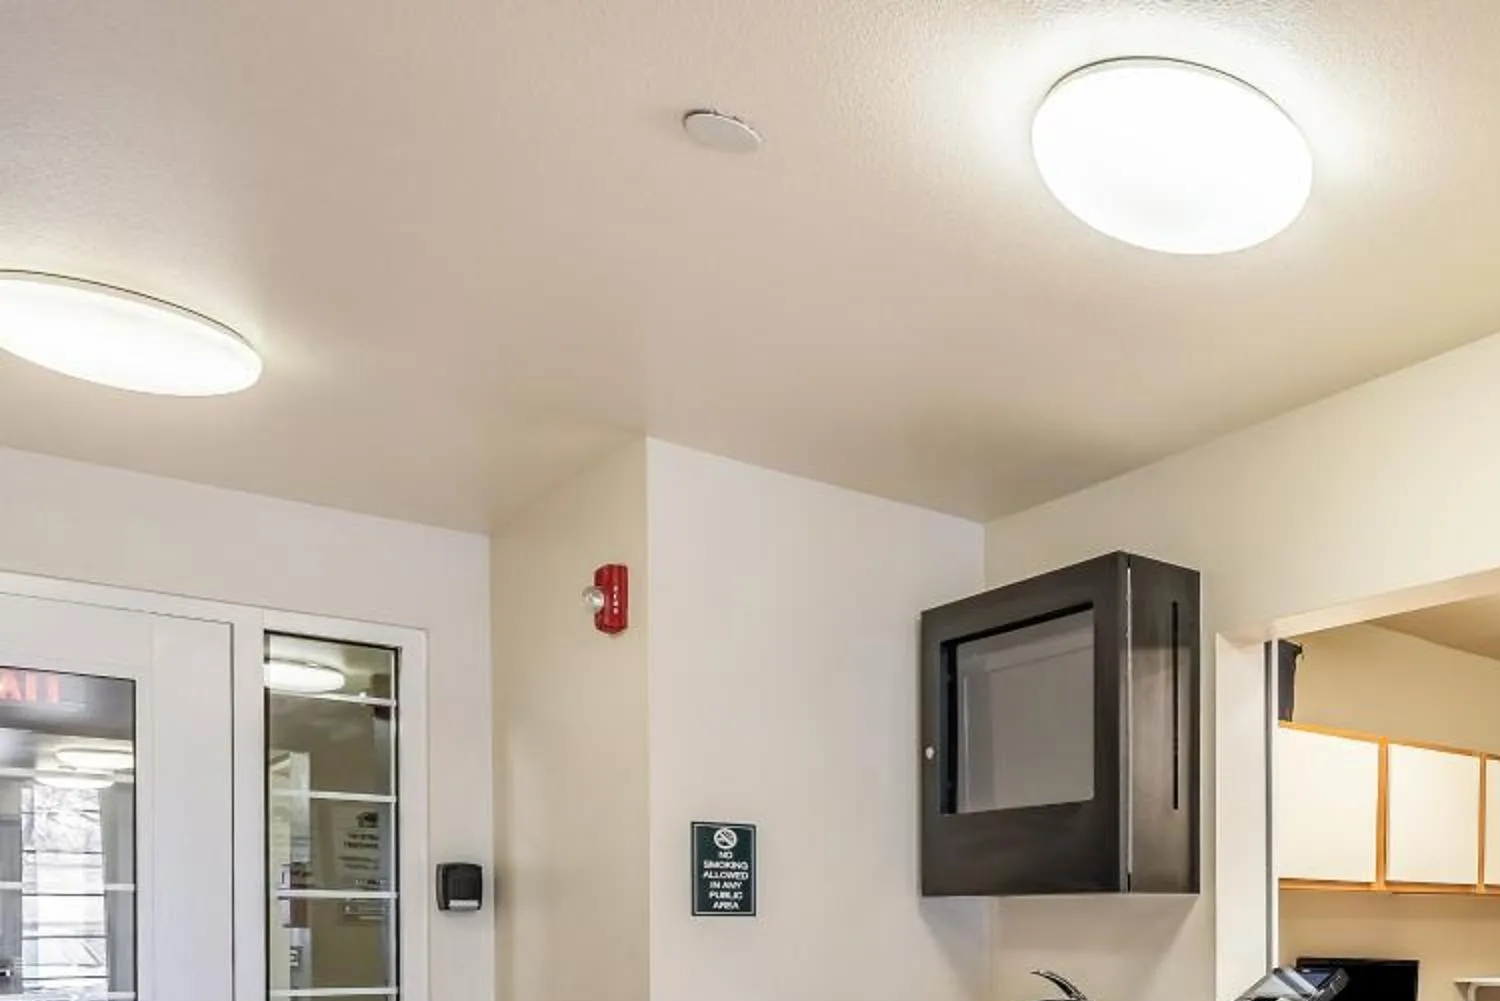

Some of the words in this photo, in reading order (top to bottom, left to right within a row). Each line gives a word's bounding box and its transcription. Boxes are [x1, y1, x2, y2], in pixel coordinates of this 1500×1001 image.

[718, 851, 733, 859] NO
[703, 860, 749, 870] SMOKING
[703, 870, 749, 879] ALLOWED
[709, 881, 720, 889] IN
[722, 881, 743, 889] ANY
[709, 891, 743, 900] PUBLIC
[713, 901, 740, 910] AREA
